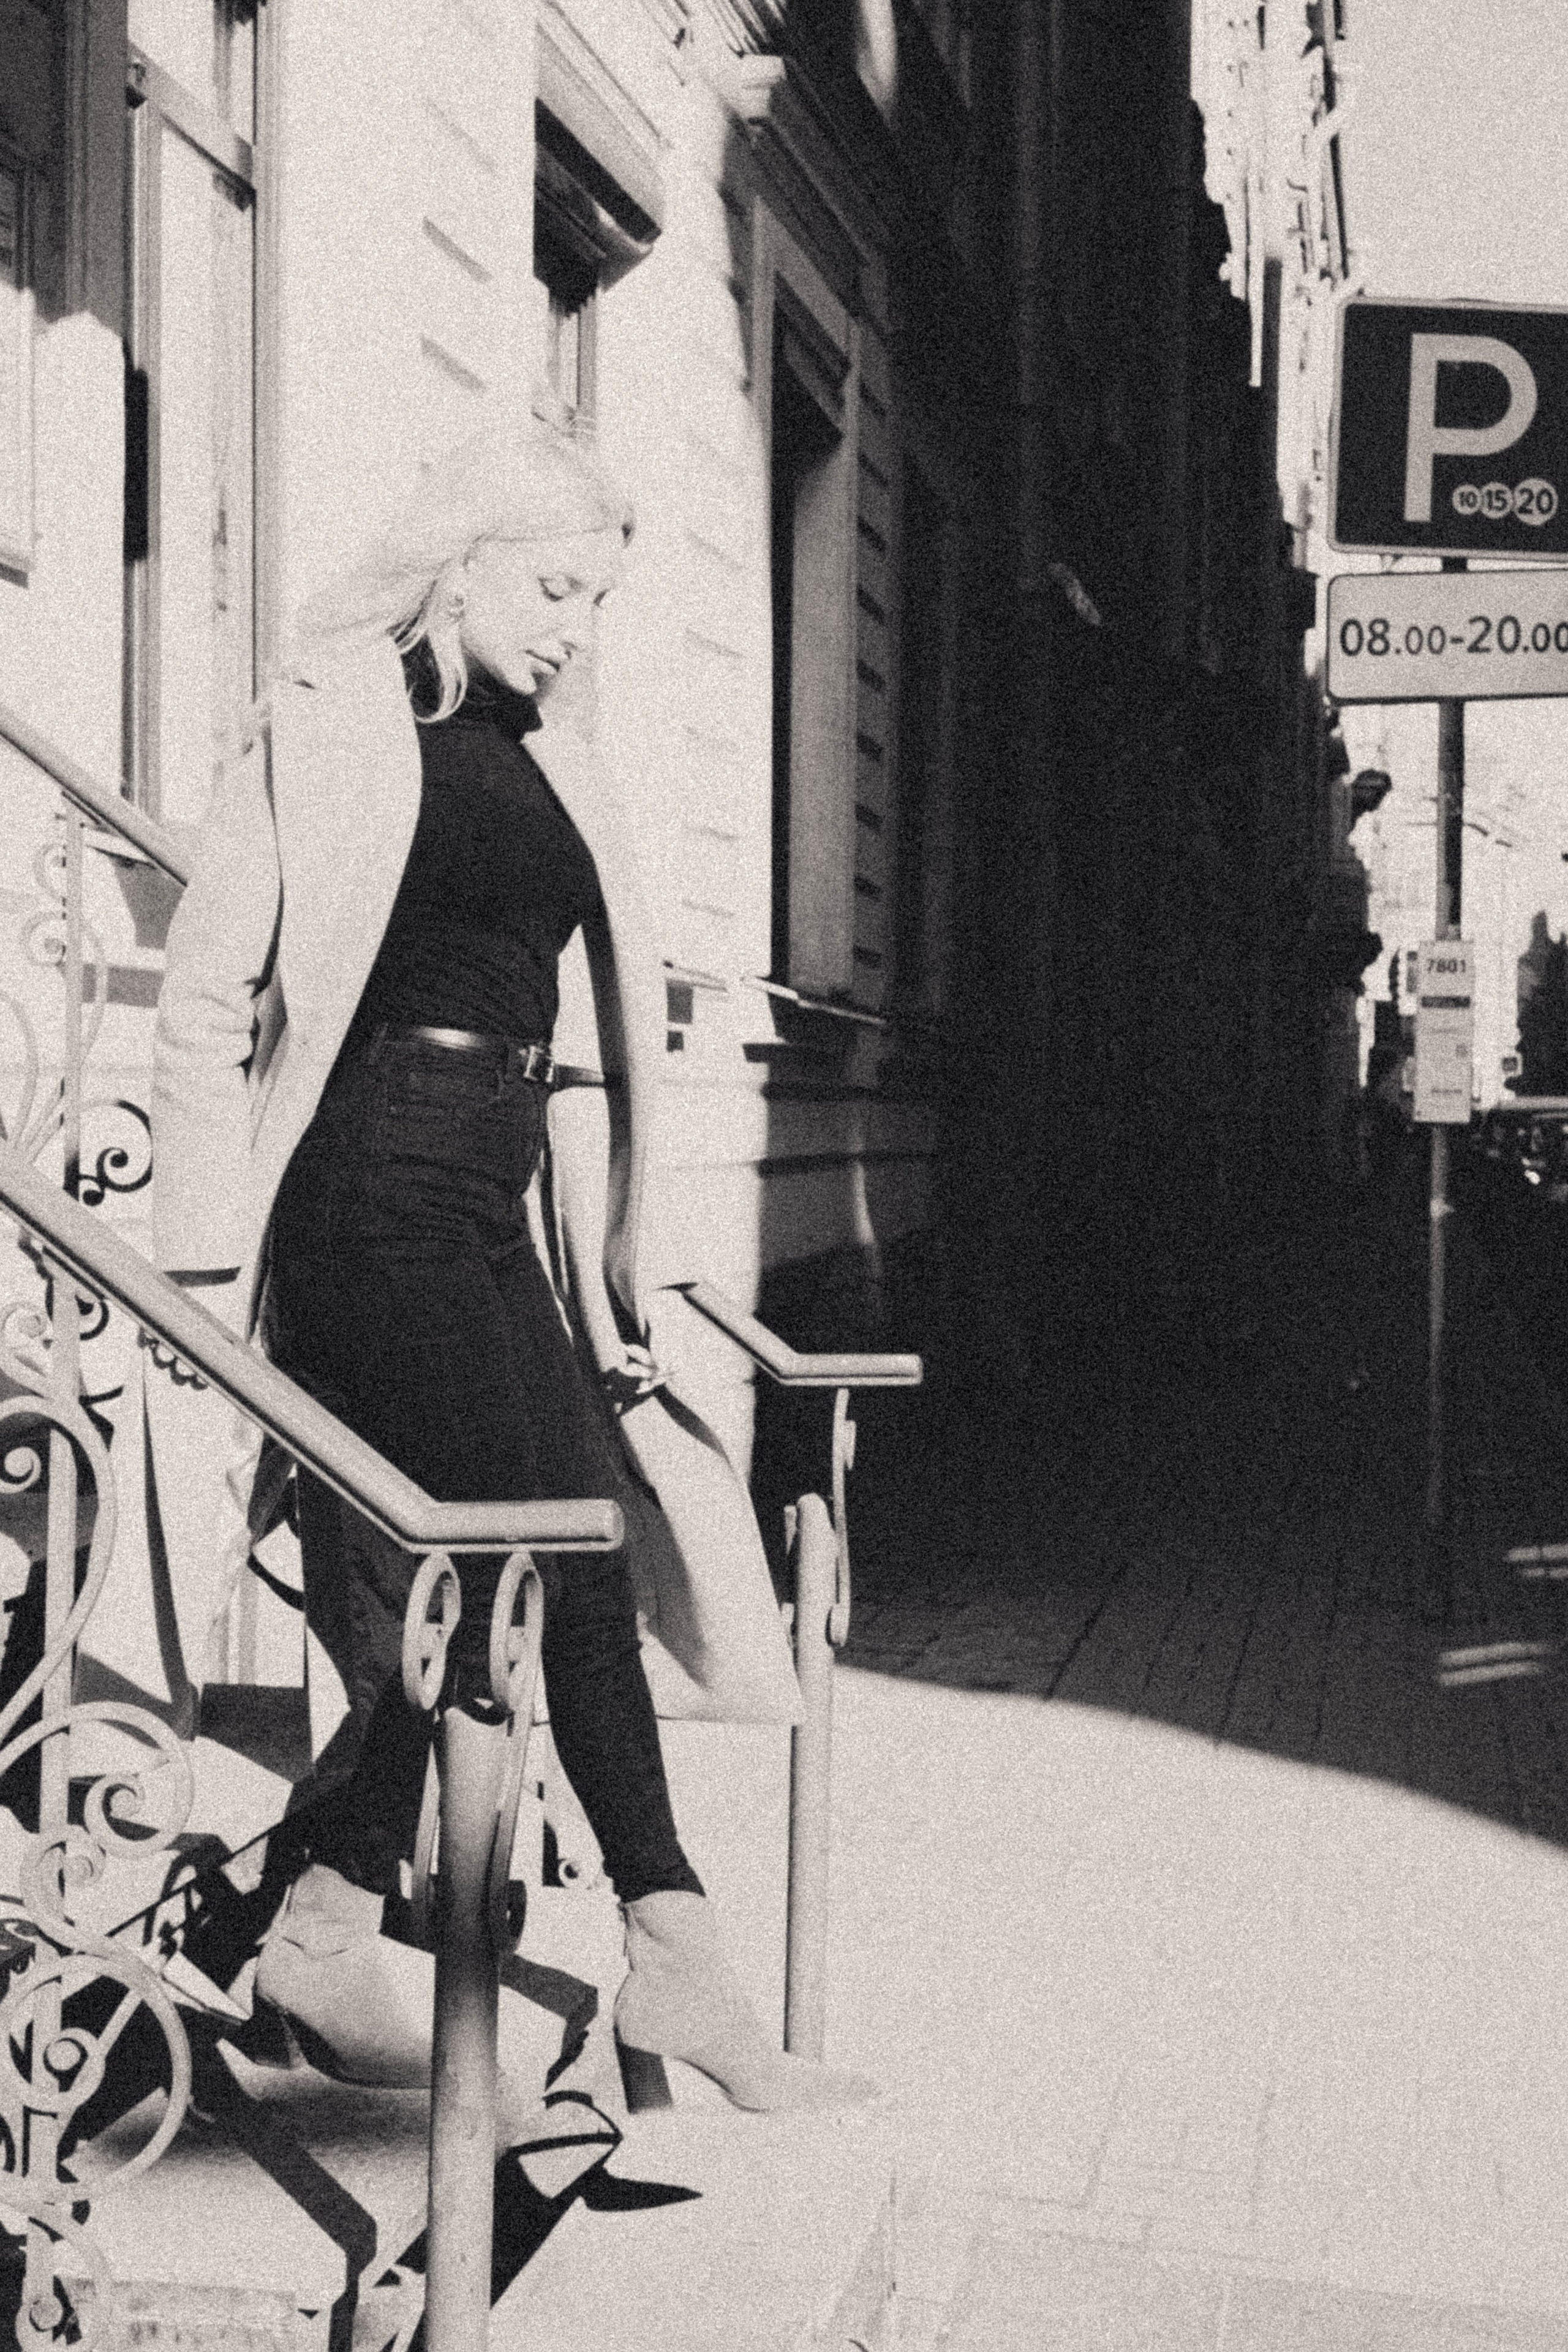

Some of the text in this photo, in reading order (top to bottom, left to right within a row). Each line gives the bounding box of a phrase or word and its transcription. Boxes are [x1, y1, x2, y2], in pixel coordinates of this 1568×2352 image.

[1406, 333, 1538, 522] P
[1458, 488, 1554, 514] 10 15 20
